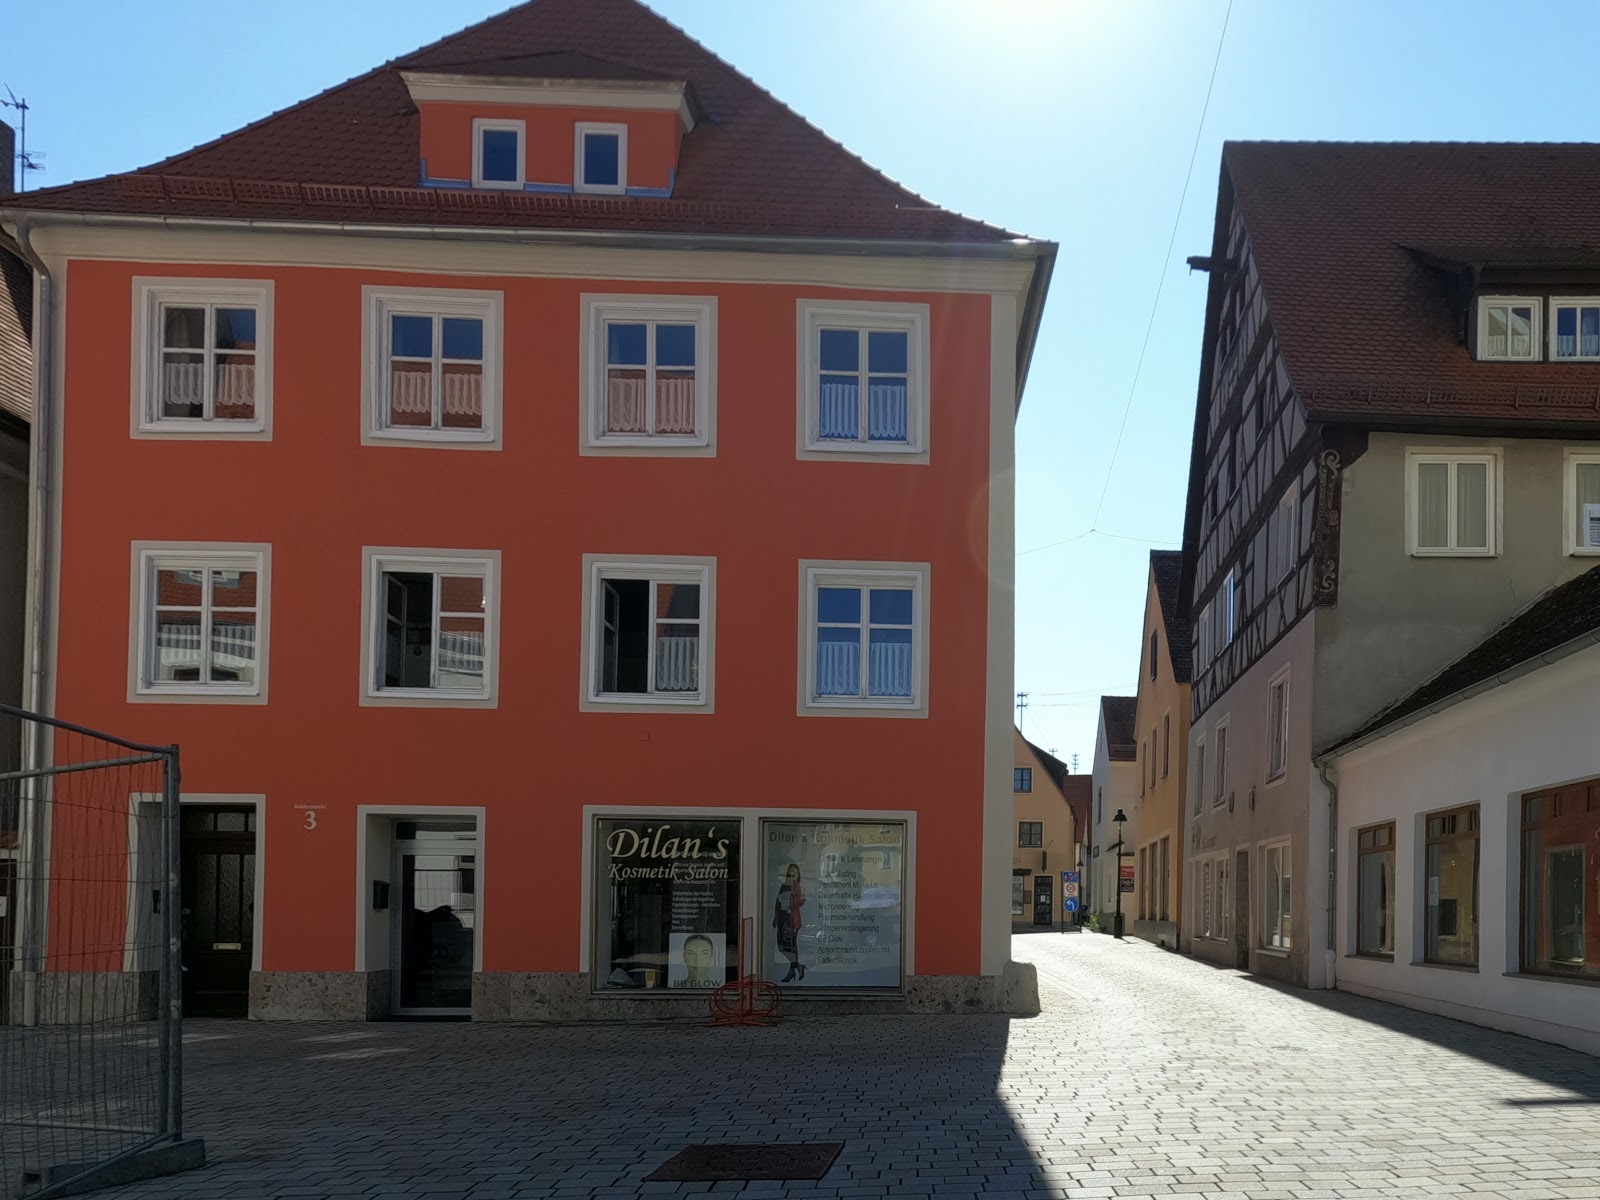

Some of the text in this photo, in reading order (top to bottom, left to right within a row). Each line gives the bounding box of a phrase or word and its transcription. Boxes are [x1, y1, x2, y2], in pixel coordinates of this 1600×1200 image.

[304, 810, 317, 830] 3
[607, 862, 729, 882] Kosmetik Salon
[673, 979, 722, 988] BB GLOW
